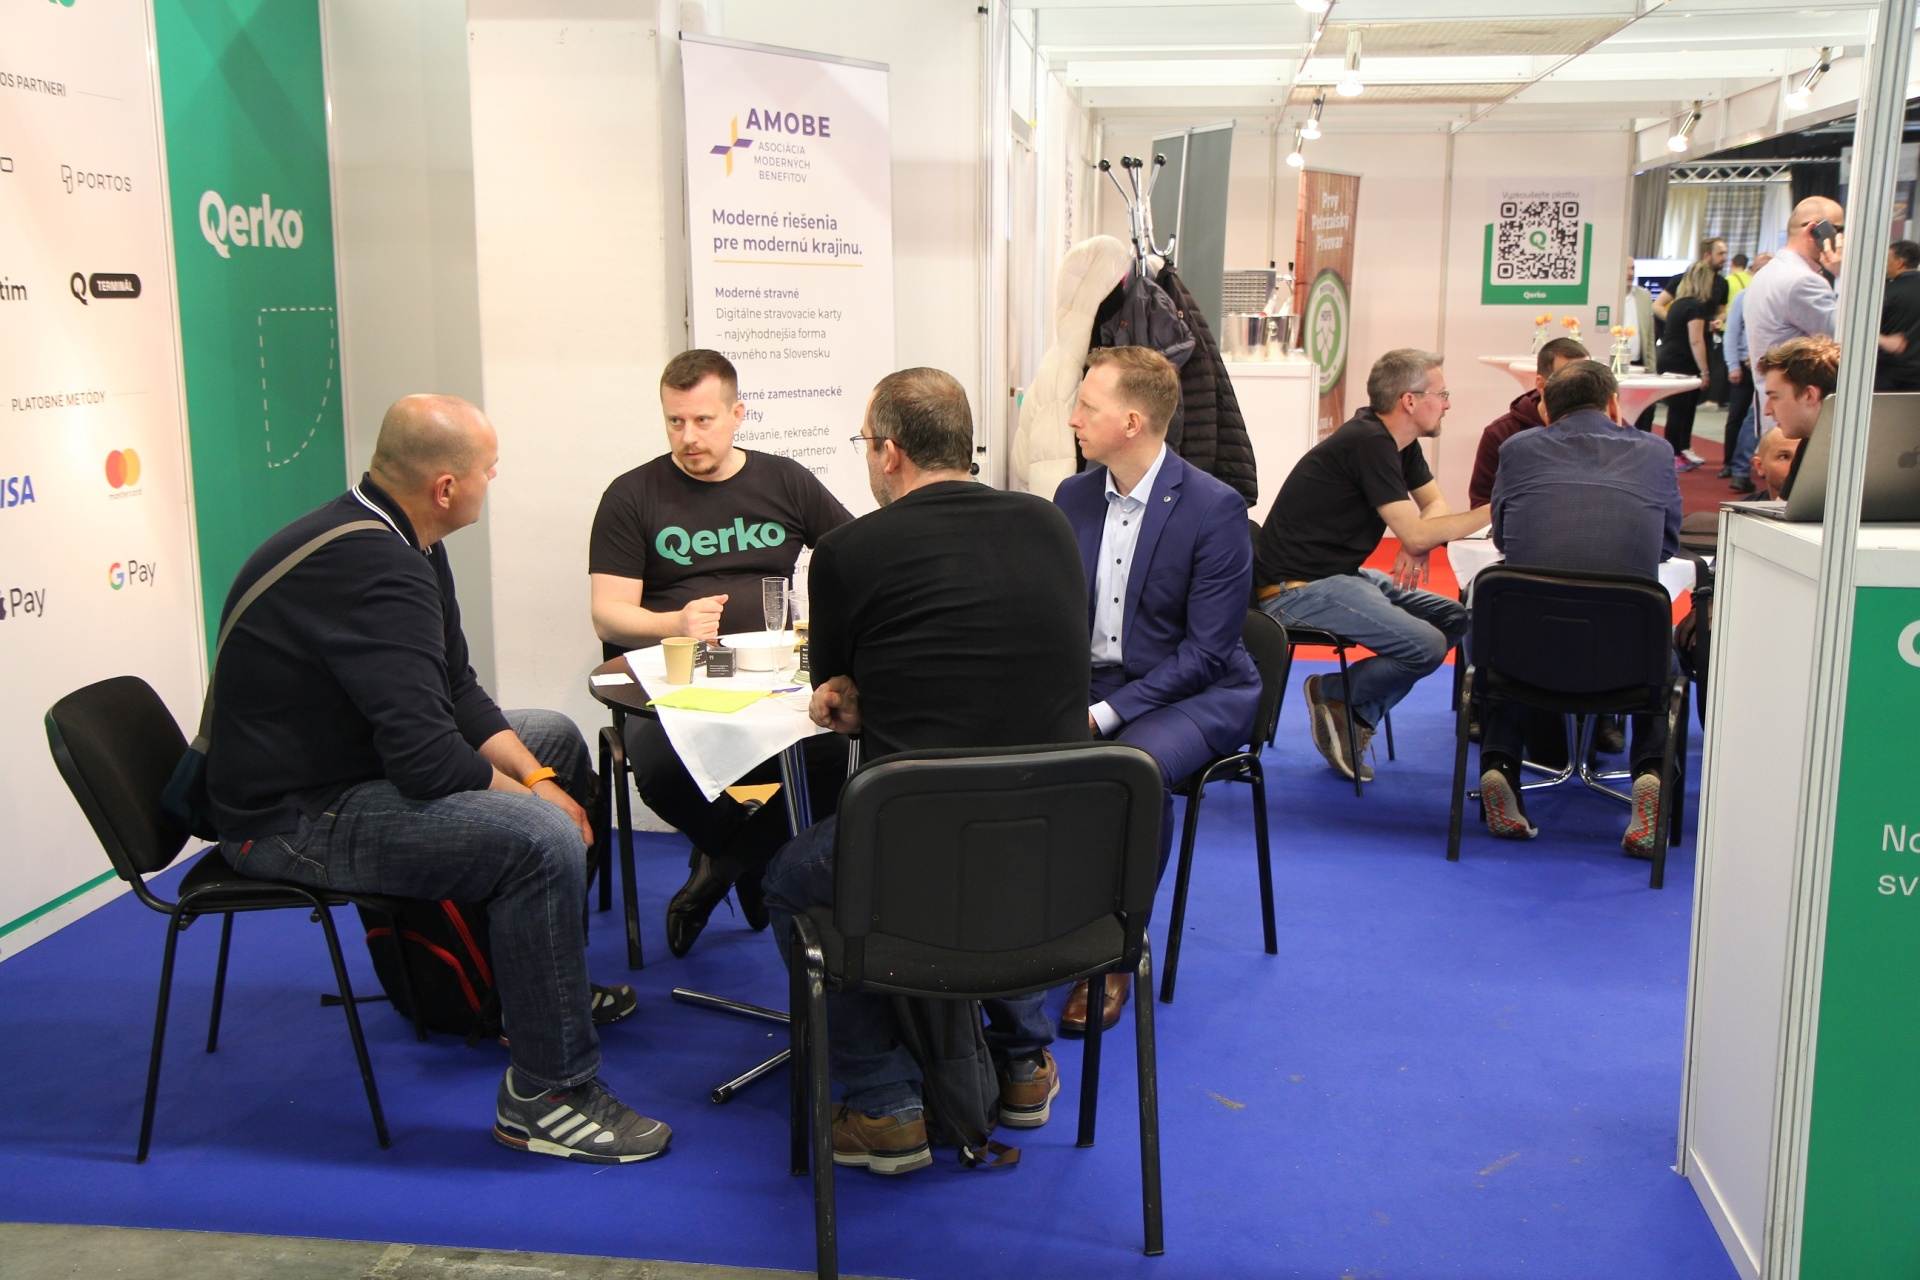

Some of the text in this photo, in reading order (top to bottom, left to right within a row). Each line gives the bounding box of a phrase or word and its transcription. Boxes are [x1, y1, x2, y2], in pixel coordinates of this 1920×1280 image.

[0, 71, 67, 97] OS PARTNERI
[746, 107, 831, 138] AMOBE
[758, 140, 806, 155] ASOCIÁCIA
[753, 155, 811, 170] MODERNÝCH
[77, 171, 132, 192] PORTOS
[758, 170, 808, 184] BENEFITOV
[198, 190, 304, 259] Qerko
[712, 208, 838, 231] Moderné riešenia
[713, 236, 863, 258] pre modernú krajinu.
[715, 286, 800, 300] Moderné stravné
[716, 307, 843, 322] Digitálne stravovacie karty
[724, 327, 796, 342] najvýhodnejšia
[798, 327, 827, 340] forma
[720, 346, 831, 361] travného na Slovensku
[737, 385, 843, 401] derné zamestnanecké
[734, 425, 831, 443] delávanie, rekreačné
[792, 444, 838, 459] partnerov
[0, 475, 35, 508] ISA
[655, 517, 786, 566] Qerko
[128, 559, 157, 588] Pay
[10, 587, 46, 618] Pay
